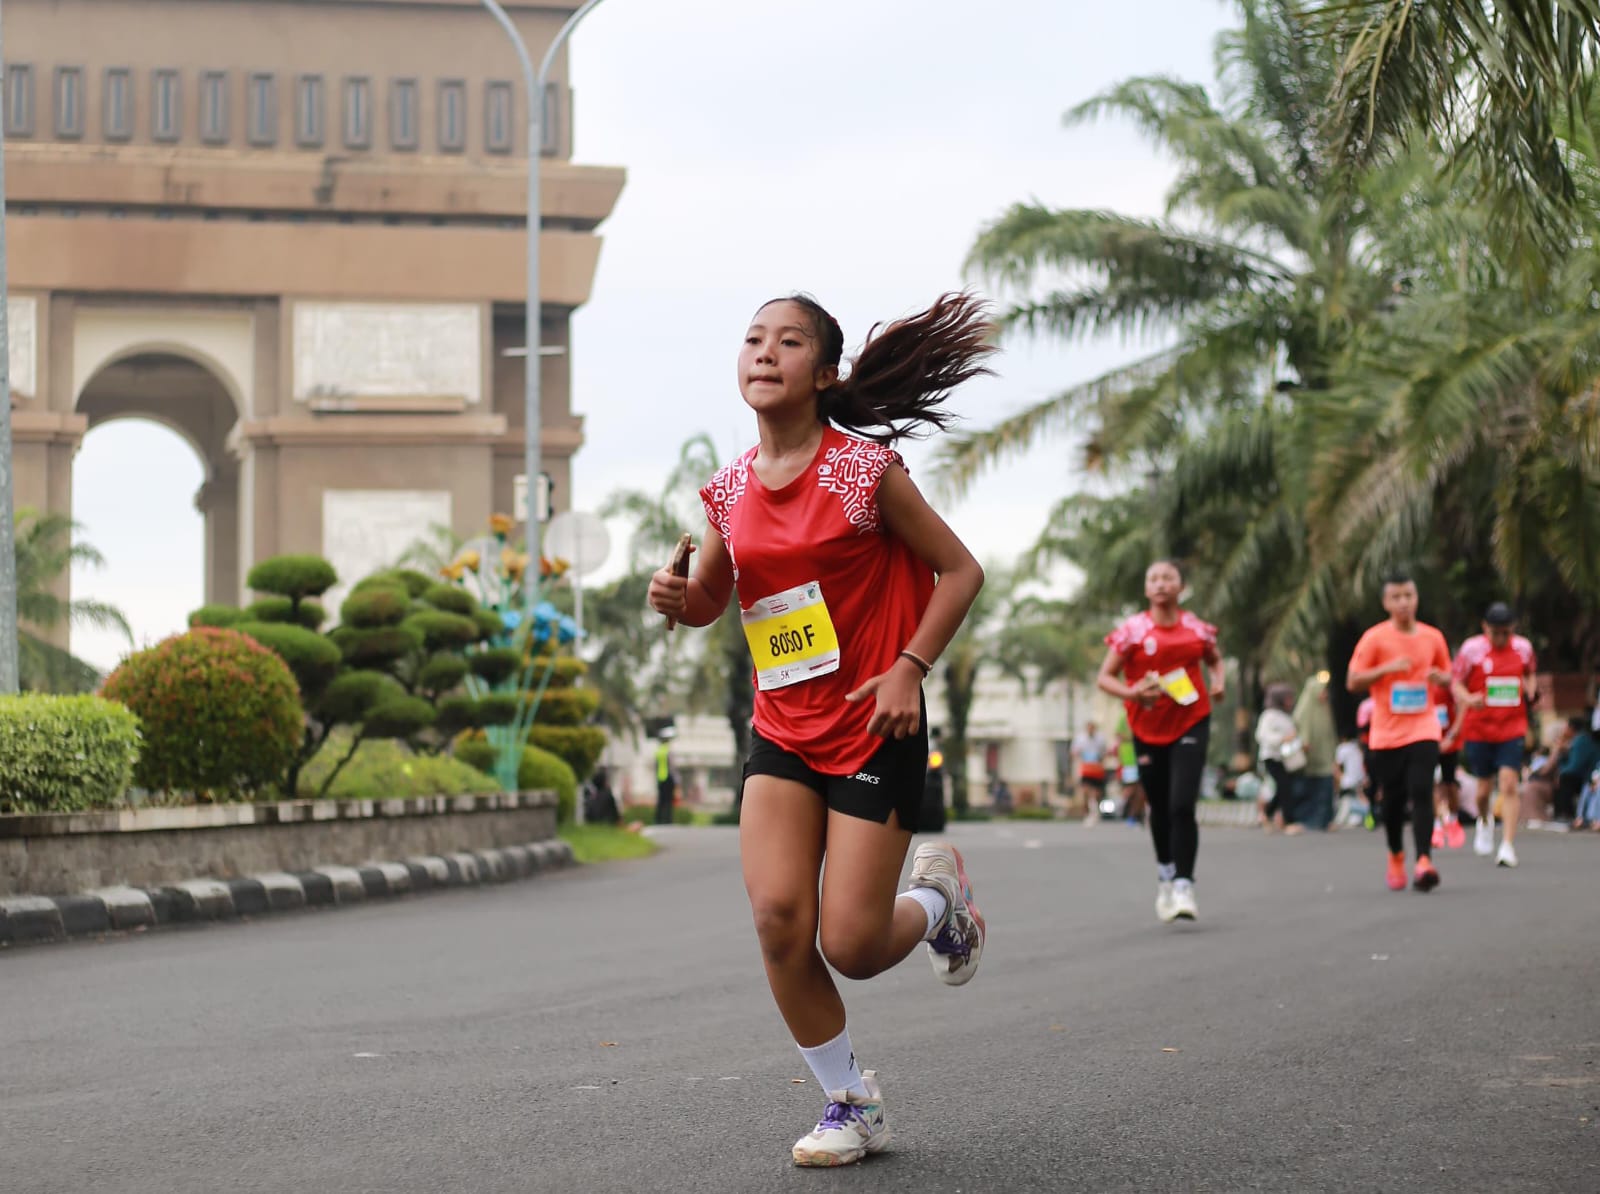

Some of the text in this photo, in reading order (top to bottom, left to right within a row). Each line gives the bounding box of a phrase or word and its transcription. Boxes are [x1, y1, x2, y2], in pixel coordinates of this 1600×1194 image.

[769, 624, 815, 657] 8050 F
[780, 669, 790, 681] 5K
